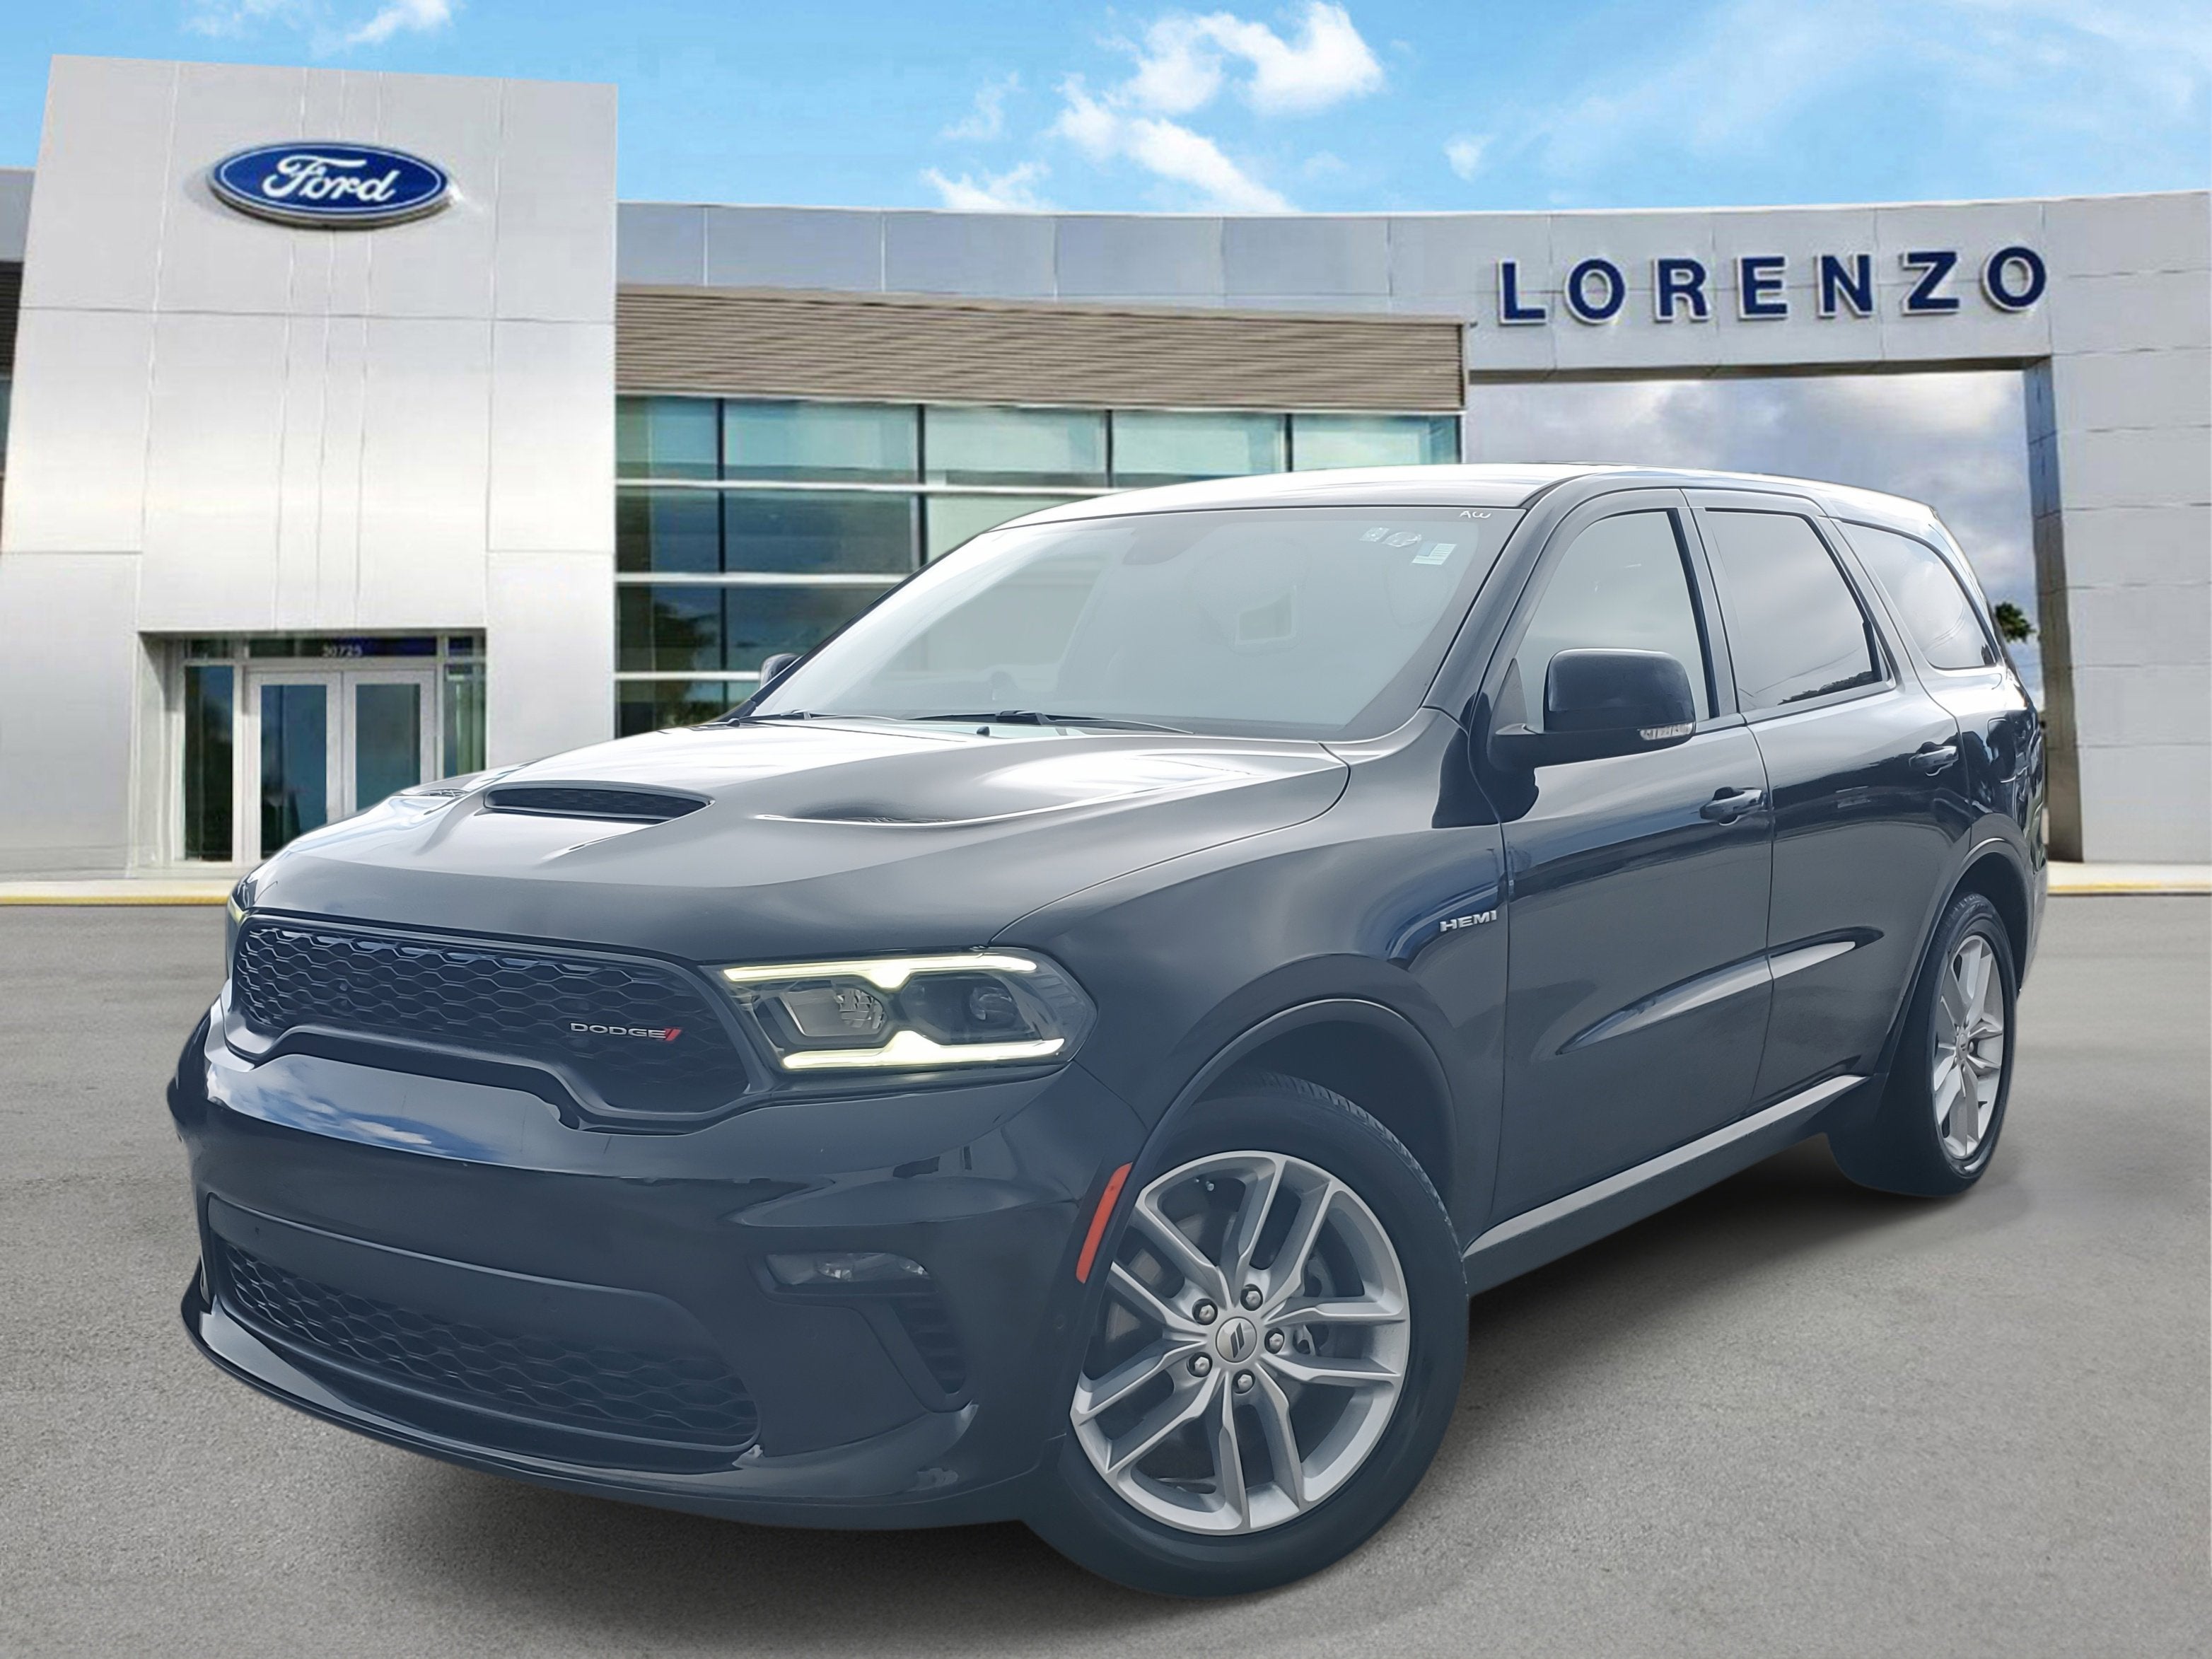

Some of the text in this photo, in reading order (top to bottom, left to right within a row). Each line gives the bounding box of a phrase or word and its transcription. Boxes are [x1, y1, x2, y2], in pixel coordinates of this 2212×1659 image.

[262, 154, 401, 203] Ford
[1498, 245, 2048, 326] LORENZO
[1440, 909, 1497, 932] HEMI
[570, 1023, 667, 1039] DODGE
